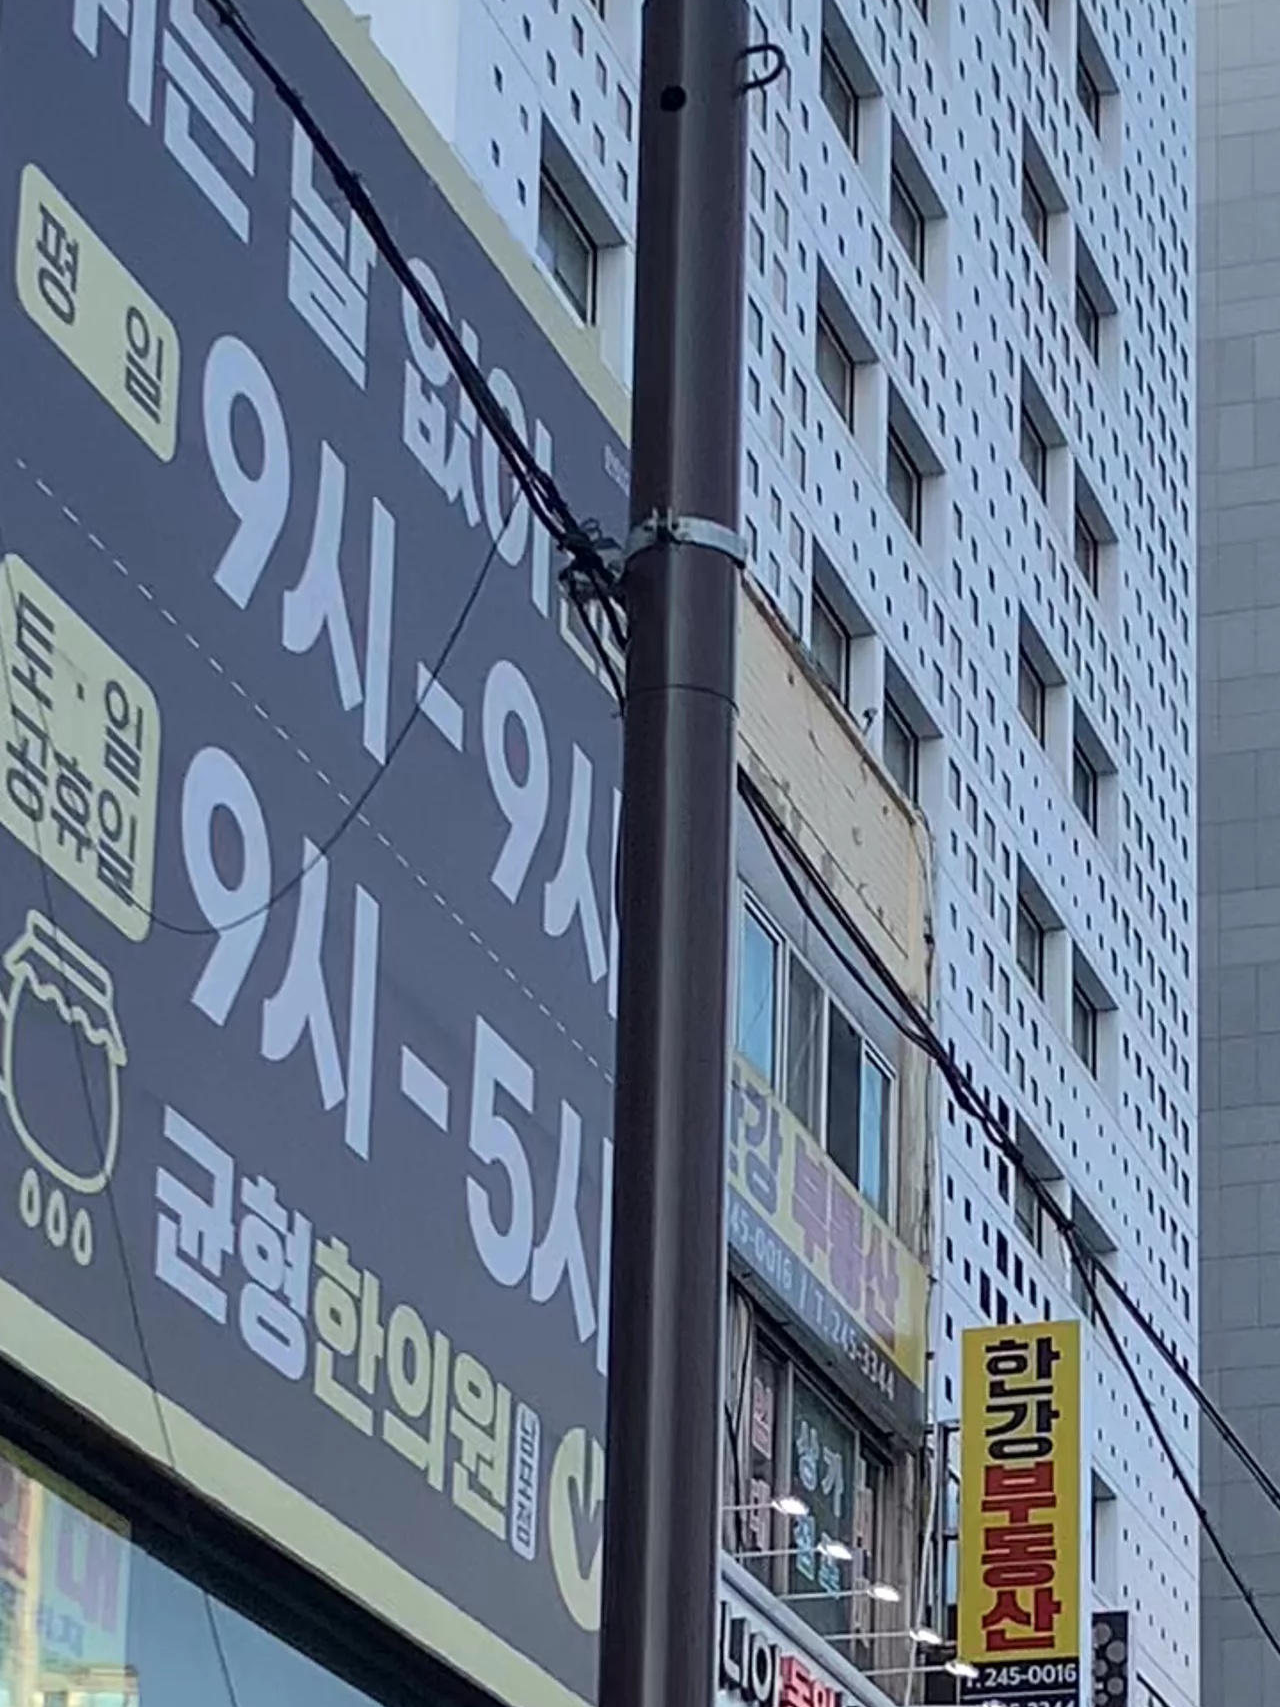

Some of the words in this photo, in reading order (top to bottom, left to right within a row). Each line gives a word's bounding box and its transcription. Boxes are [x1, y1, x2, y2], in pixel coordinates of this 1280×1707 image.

[36, 200, 165, 424] 평일
[400, 257, 554, 619] 없이
[5, 702, 138, 908] 공휴일
[792, 1145, 900, 1355] 부동산
[984, 1663, 1078, 1689] 245-0016
